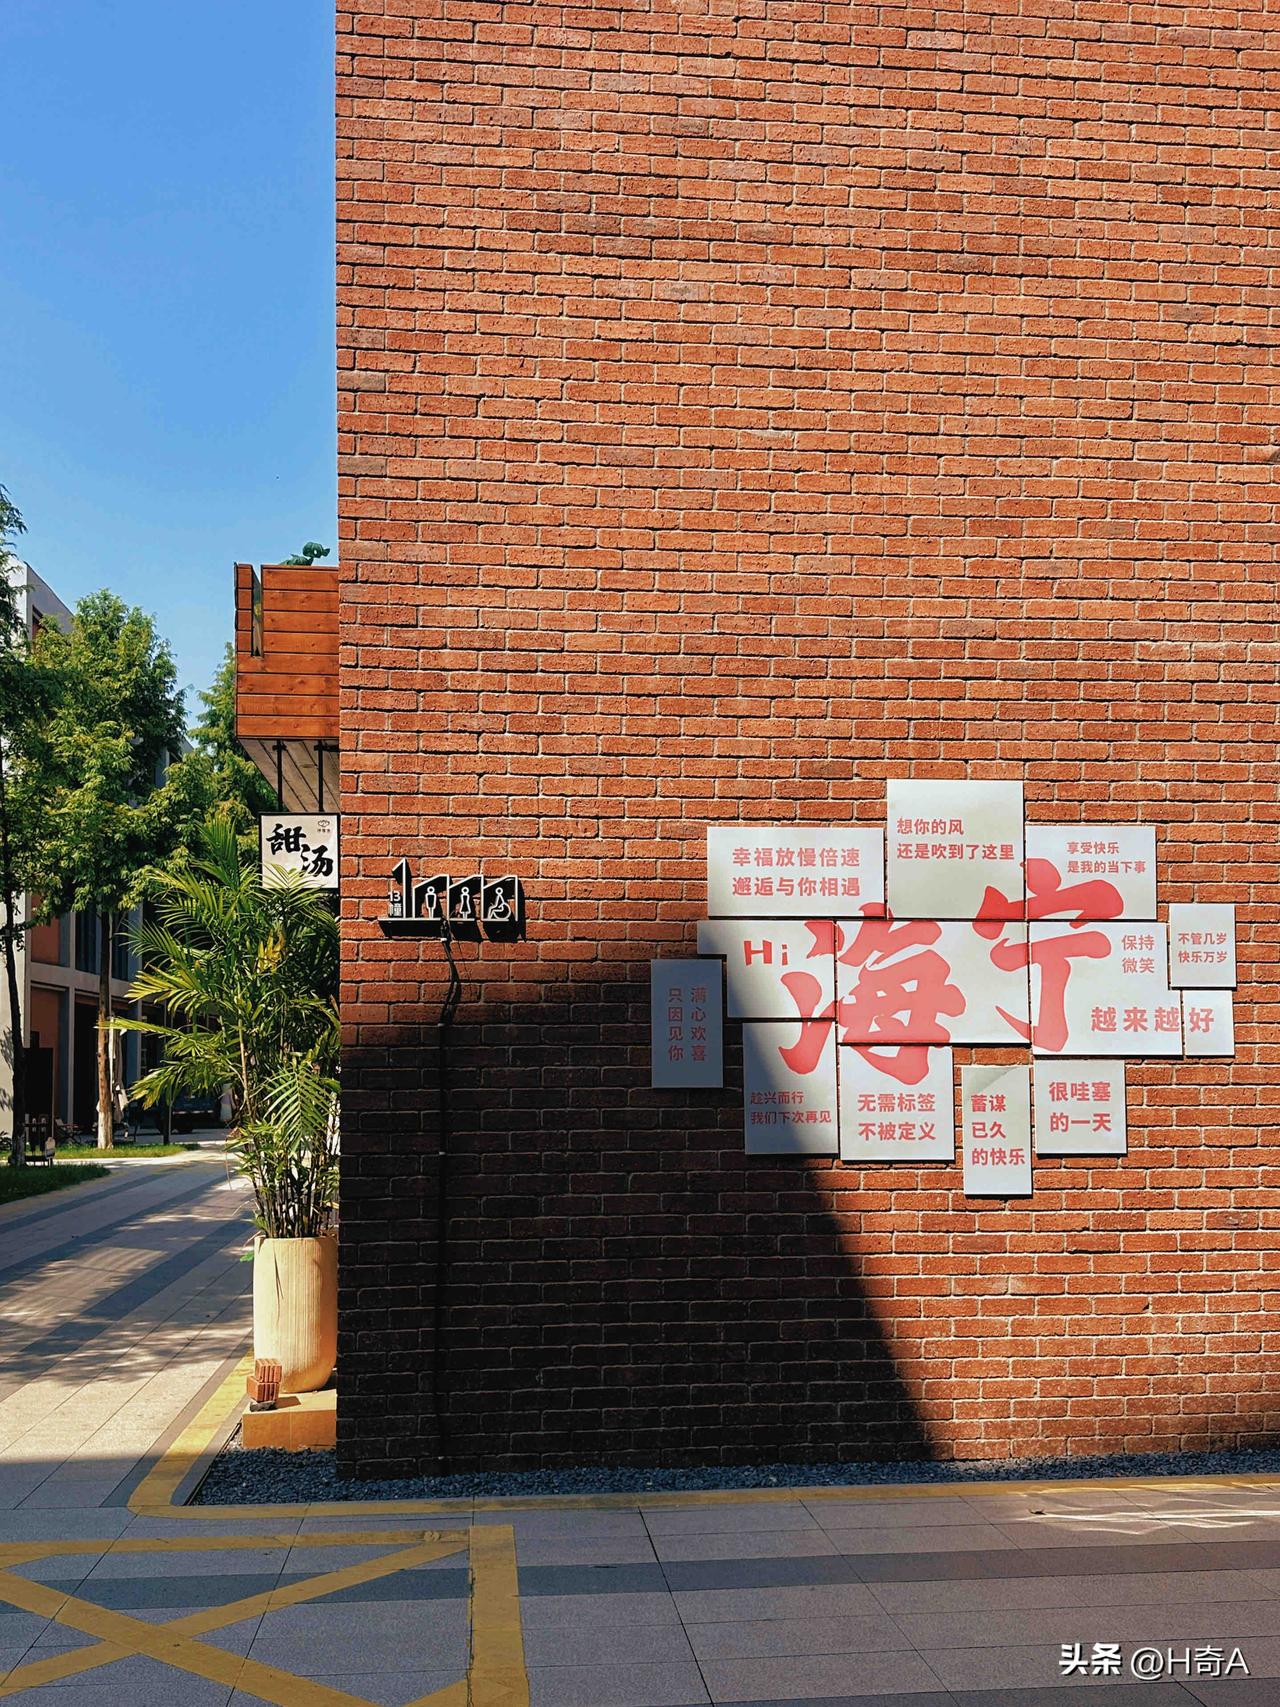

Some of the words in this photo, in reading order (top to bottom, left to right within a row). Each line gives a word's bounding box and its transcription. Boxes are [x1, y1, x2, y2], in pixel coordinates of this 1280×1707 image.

[897, 818, 964, 835] 想你的风
[265, 823, 334, 878] 甜汤
[732, 847, 860, 867] 幸福放慢倍速
[897, 843, 1014, 860] 还是吹到了这里
[1067, 842, 1119, 855] 享受快乐
[1067, 861, 1146, 874] 是我的当下事
[388, 890, 401, 901] 13
[732, 877, 860, 897] 邂逅与你相遇
[1121, 934, 1155, 951] 保持
[1178, 933, 1227, 945] 不管几岁
[1121, 957, 1155, 974] 微笑
[1178, 951, 1227, 964] 快乐万岁
[743, 939, 789, 966] Hi
[778, 857, 1124, 1085] 海宁
[668, 987, 684, 1062] 只因见你
[690, 986, 708, 1062] 满心欢喜
[1091, 1006, 1215, 1033] 越来越好
[751, 1091, 804, 1105] 趁兴而行
[1049, 1081, 1112, 1102] 很哇塞
[857, 1093, 936, 1112] 无需标签
[971, 1094, 1007, 1113] 蓄谋
[751, 1110, 832, 1125] 我们下次再见
[1049, 1112, 1113, 1133] 的一天
[858, 1121, 937, 1141] 不被定义
[971, 1121, 1007, 1140] 已久
[971, 1148, 1026, 1167] 的快乐
